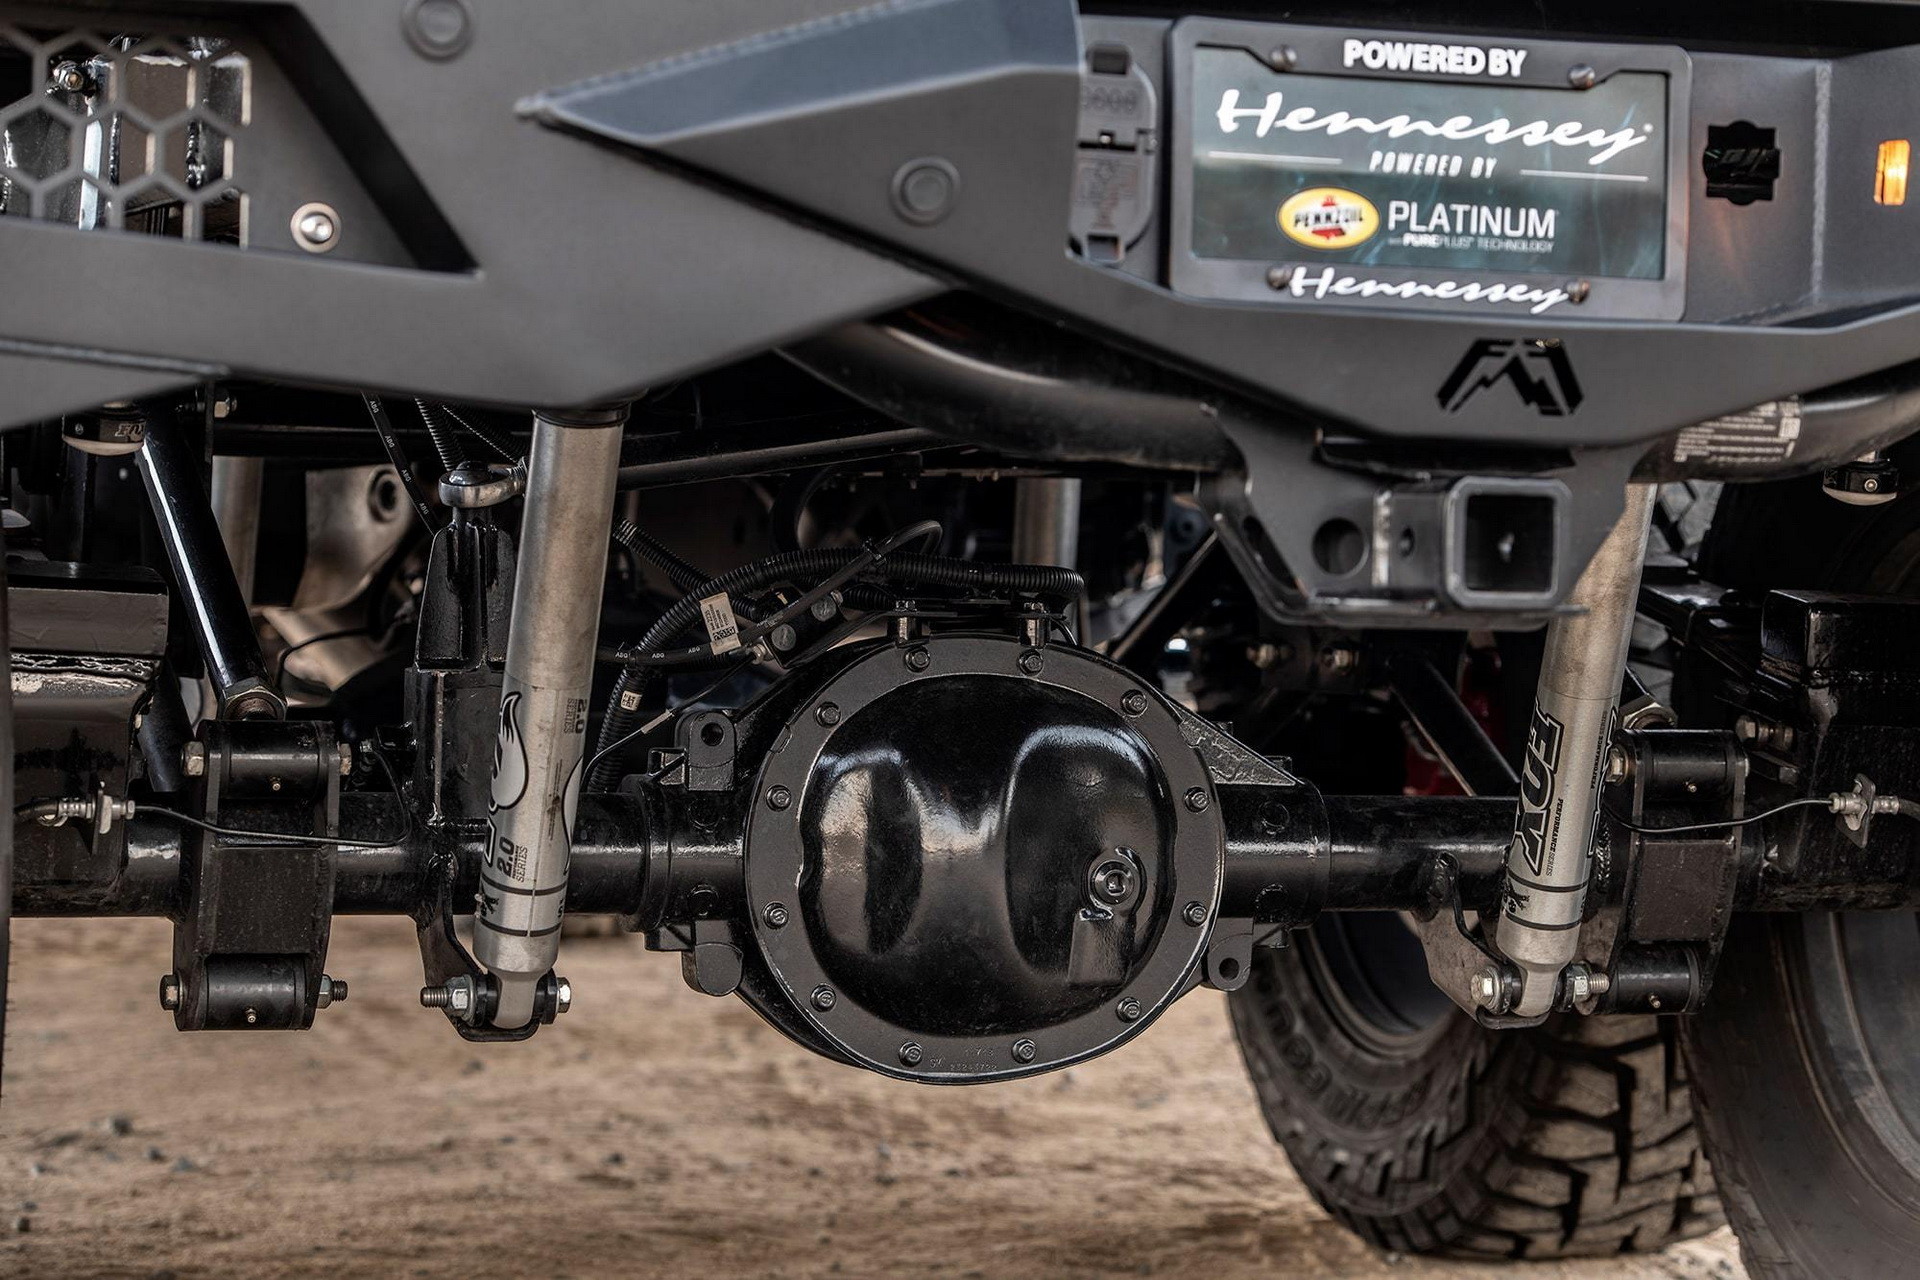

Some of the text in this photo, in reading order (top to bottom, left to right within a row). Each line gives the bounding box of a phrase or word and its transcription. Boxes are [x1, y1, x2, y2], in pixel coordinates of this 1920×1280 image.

[1343, 39, 1527, 77] POWERED BY
[1216, 88, 1648, 166] Hennessey
[1368, 150, 1498, 179] POWERED BY
[1387, 200, 1555, 239] PLATINUM
[1288, 266, 1570, 315] Hennessey
[575, 698, 588, 734] 2.0
[1512, 700, 1564, 876] FOX
[1550, 797, 1564, 852] PERFORMANCE
[496, 836, 516, 878] 2.0
[516, 845, 528, 883] SERIES
